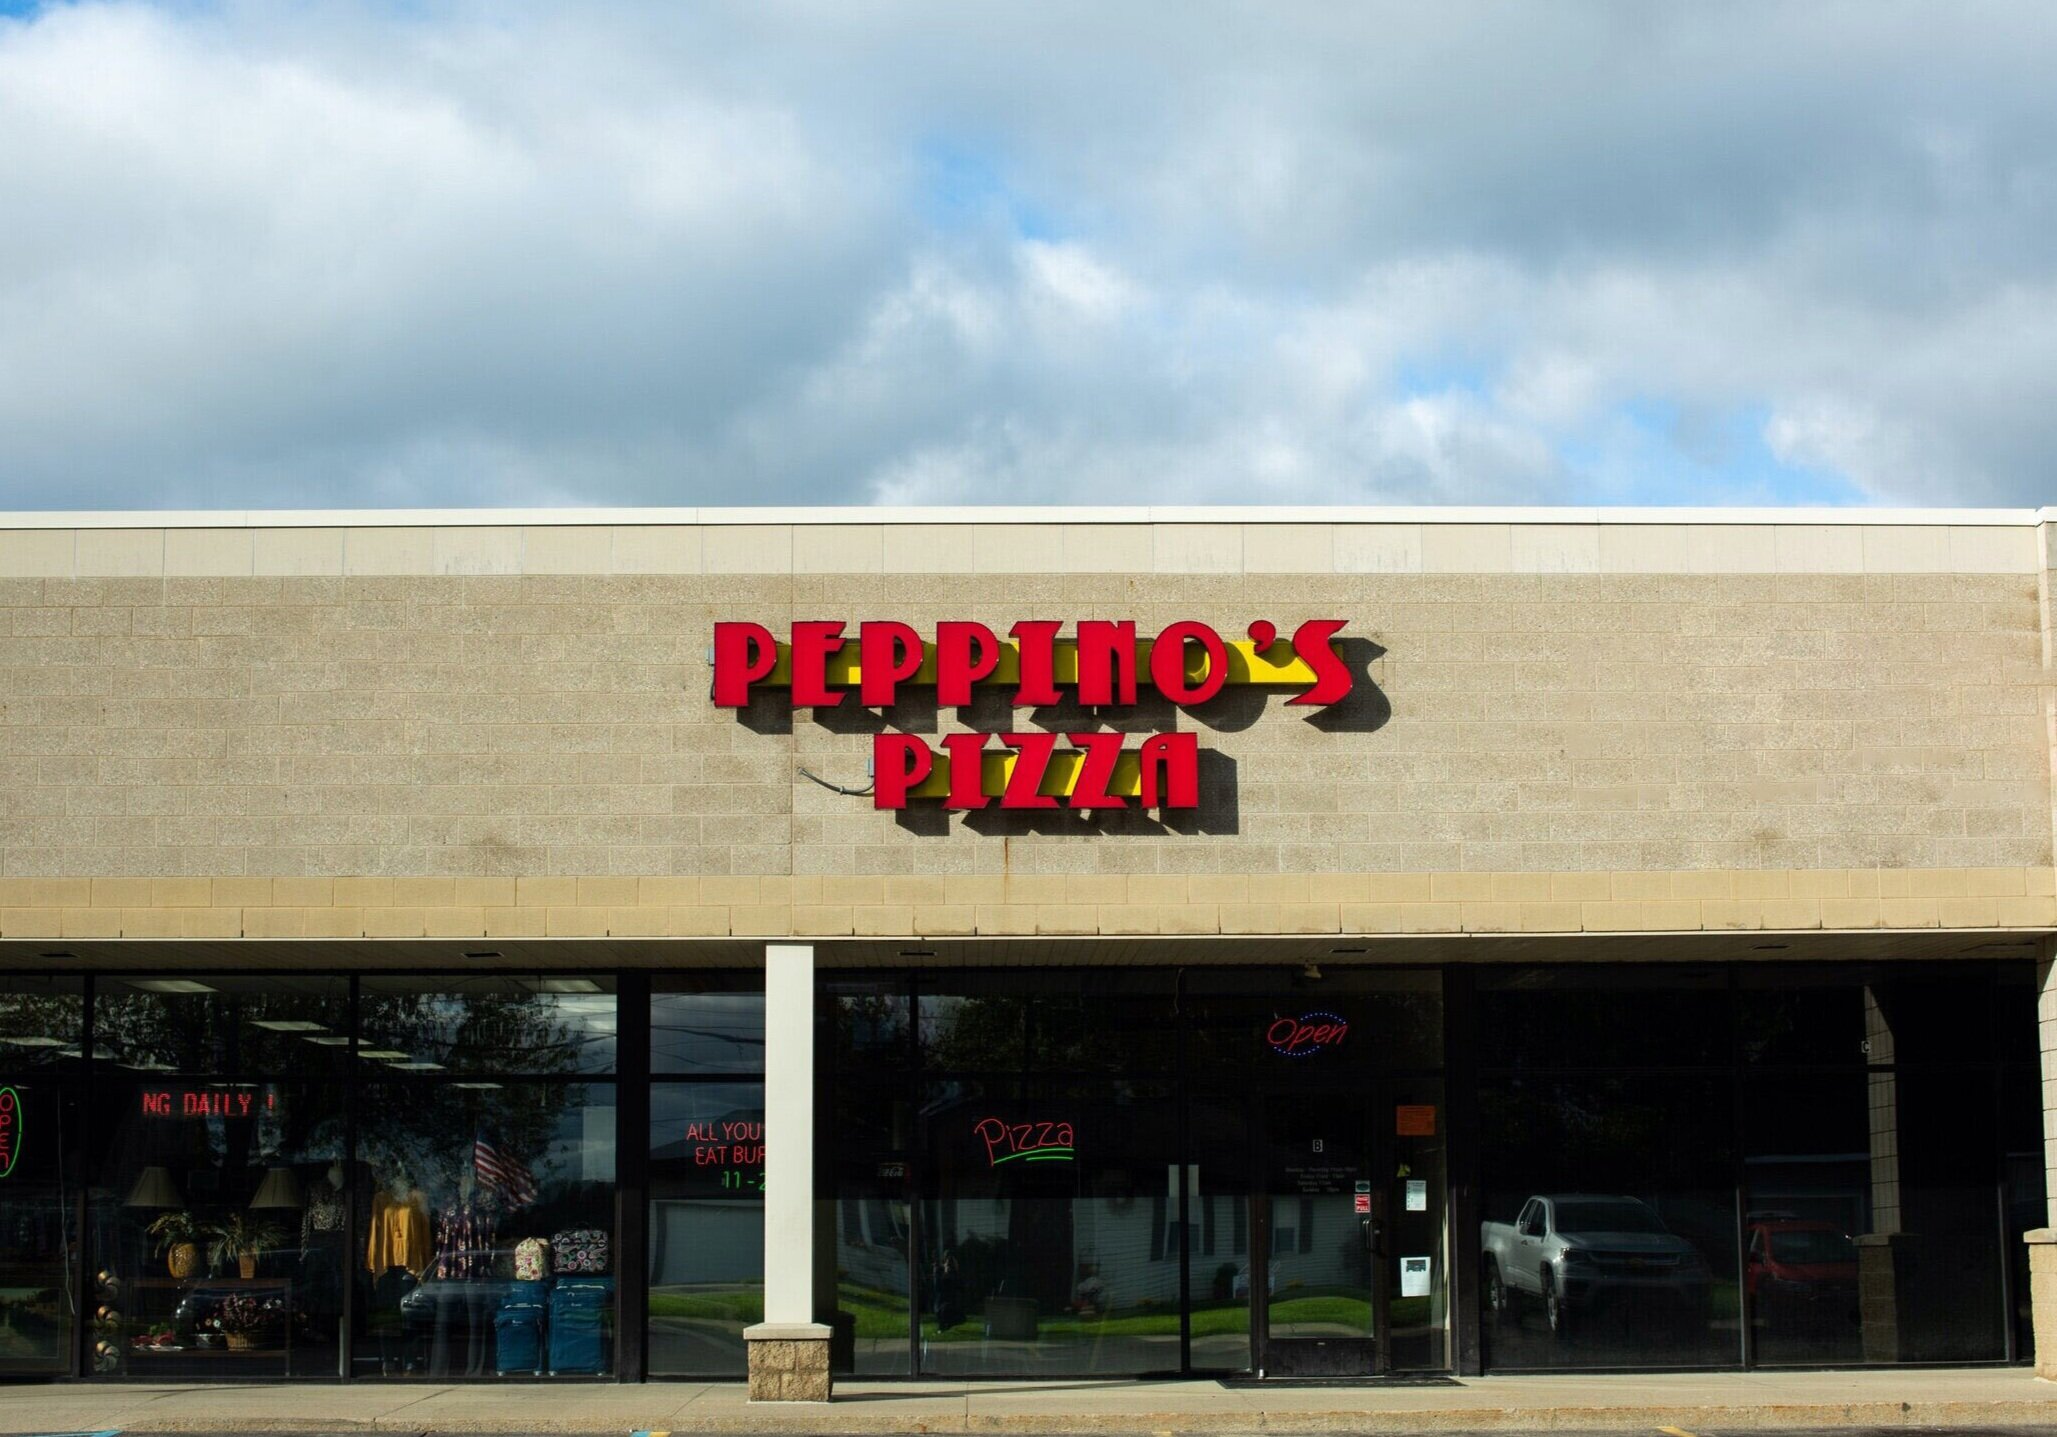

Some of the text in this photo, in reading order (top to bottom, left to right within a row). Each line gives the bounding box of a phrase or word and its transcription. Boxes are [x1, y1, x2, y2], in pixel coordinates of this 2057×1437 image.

[714, 619, 1353, 708] PEPPINO'S
[873, 732, 1198, 811] PIZZA
[1267, 1018, 1348, 1052] Open
[183, 1092, 252, 1116] DAILY
[686, 1122, 761, 1141] ALL YOU
[974, 1118, 1074, 1167] Pizza
[695, 1146, 729, 1165] EAT
